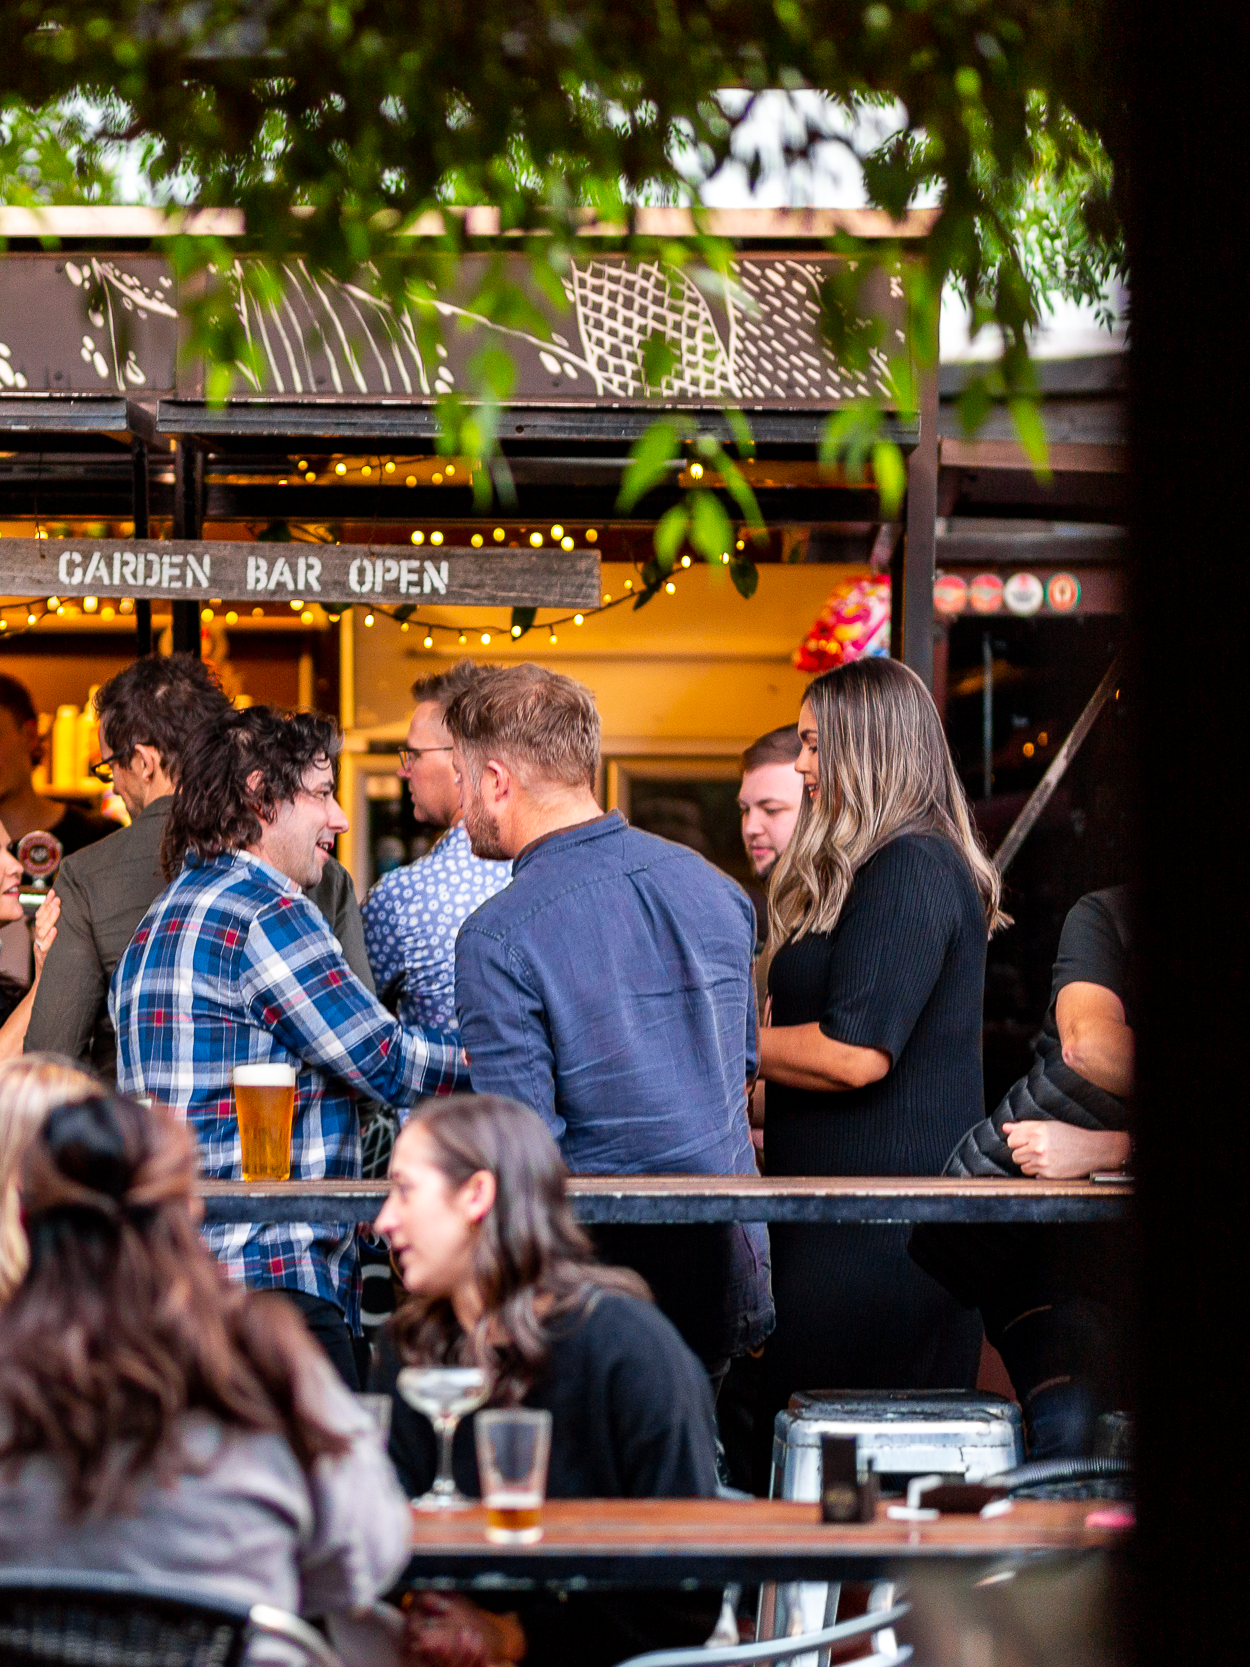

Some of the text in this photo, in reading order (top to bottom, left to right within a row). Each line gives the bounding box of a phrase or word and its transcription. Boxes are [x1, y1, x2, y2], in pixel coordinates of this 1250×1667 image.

[58, 551, 449, 595] GARDEN BAR OPEN
